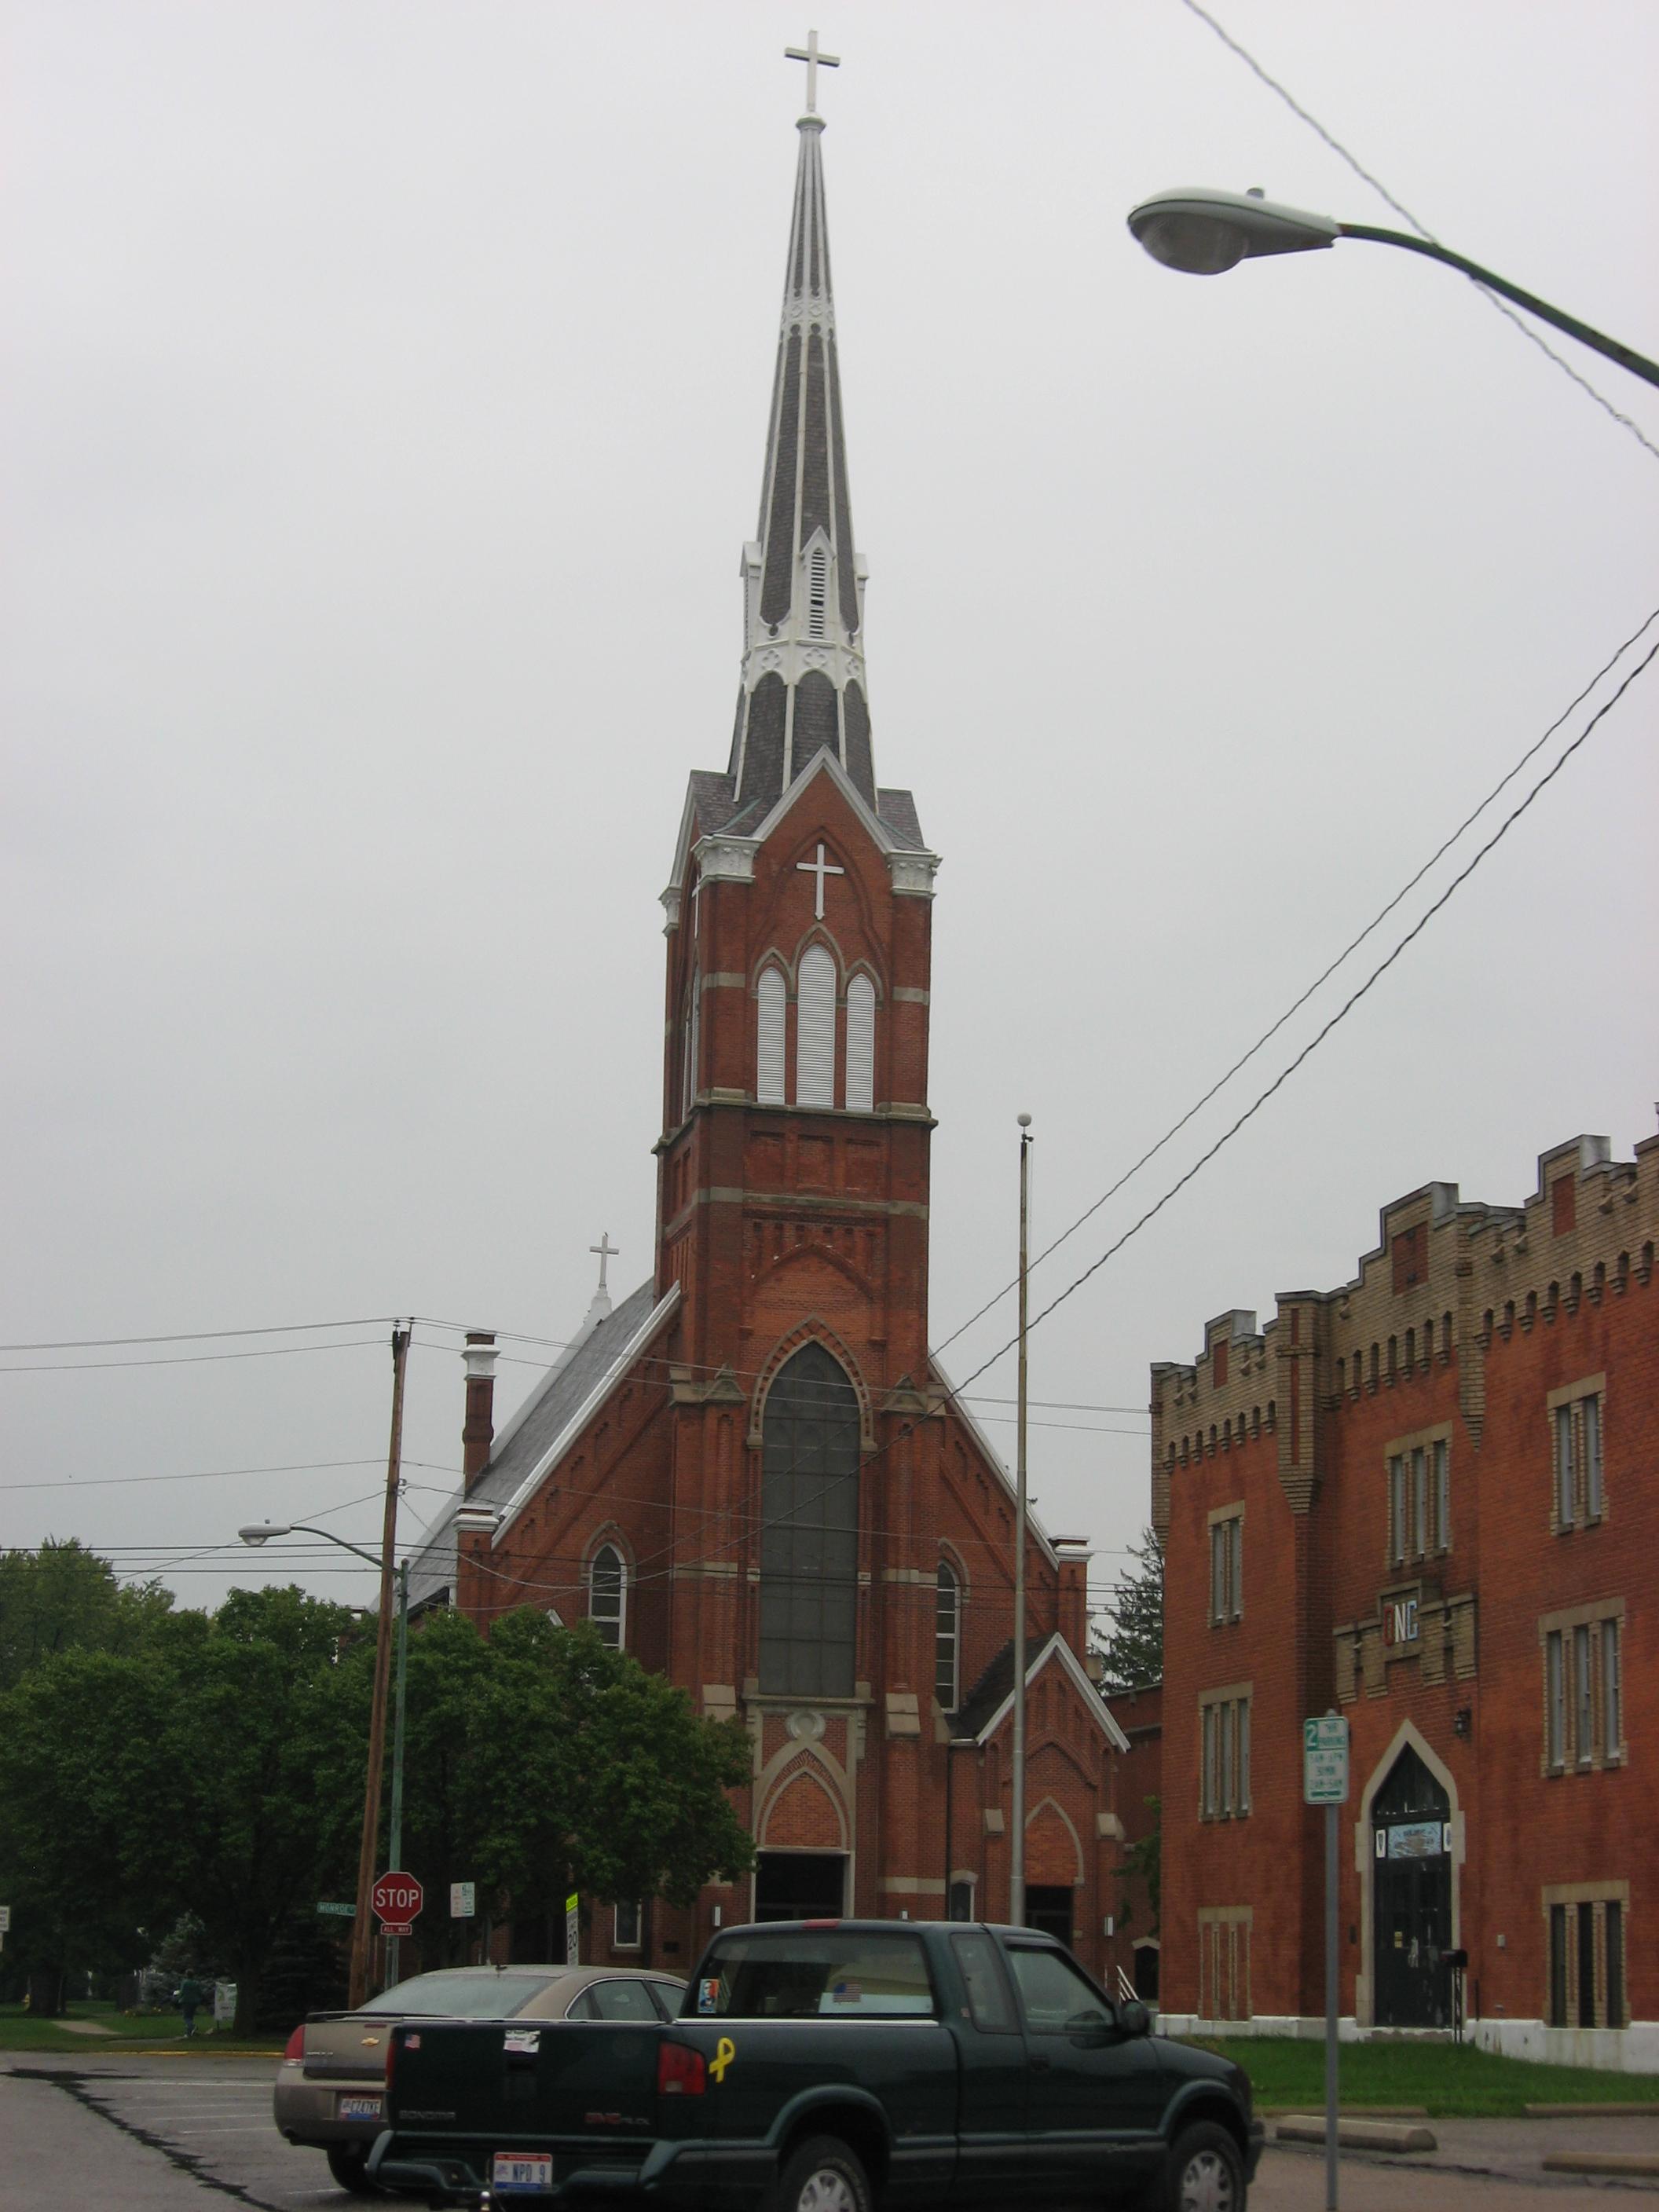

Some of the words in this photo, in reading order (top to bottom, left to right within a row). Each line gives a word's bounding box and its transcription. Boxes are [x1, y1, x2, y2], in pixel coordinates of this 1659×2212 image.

[1306, 1723, 1317, 1747] 2
[376, 1888, 419, 1908] STOP
[318, 1904, 348, 1914] MONROE
[568, 1930, 578, 1951] 20
